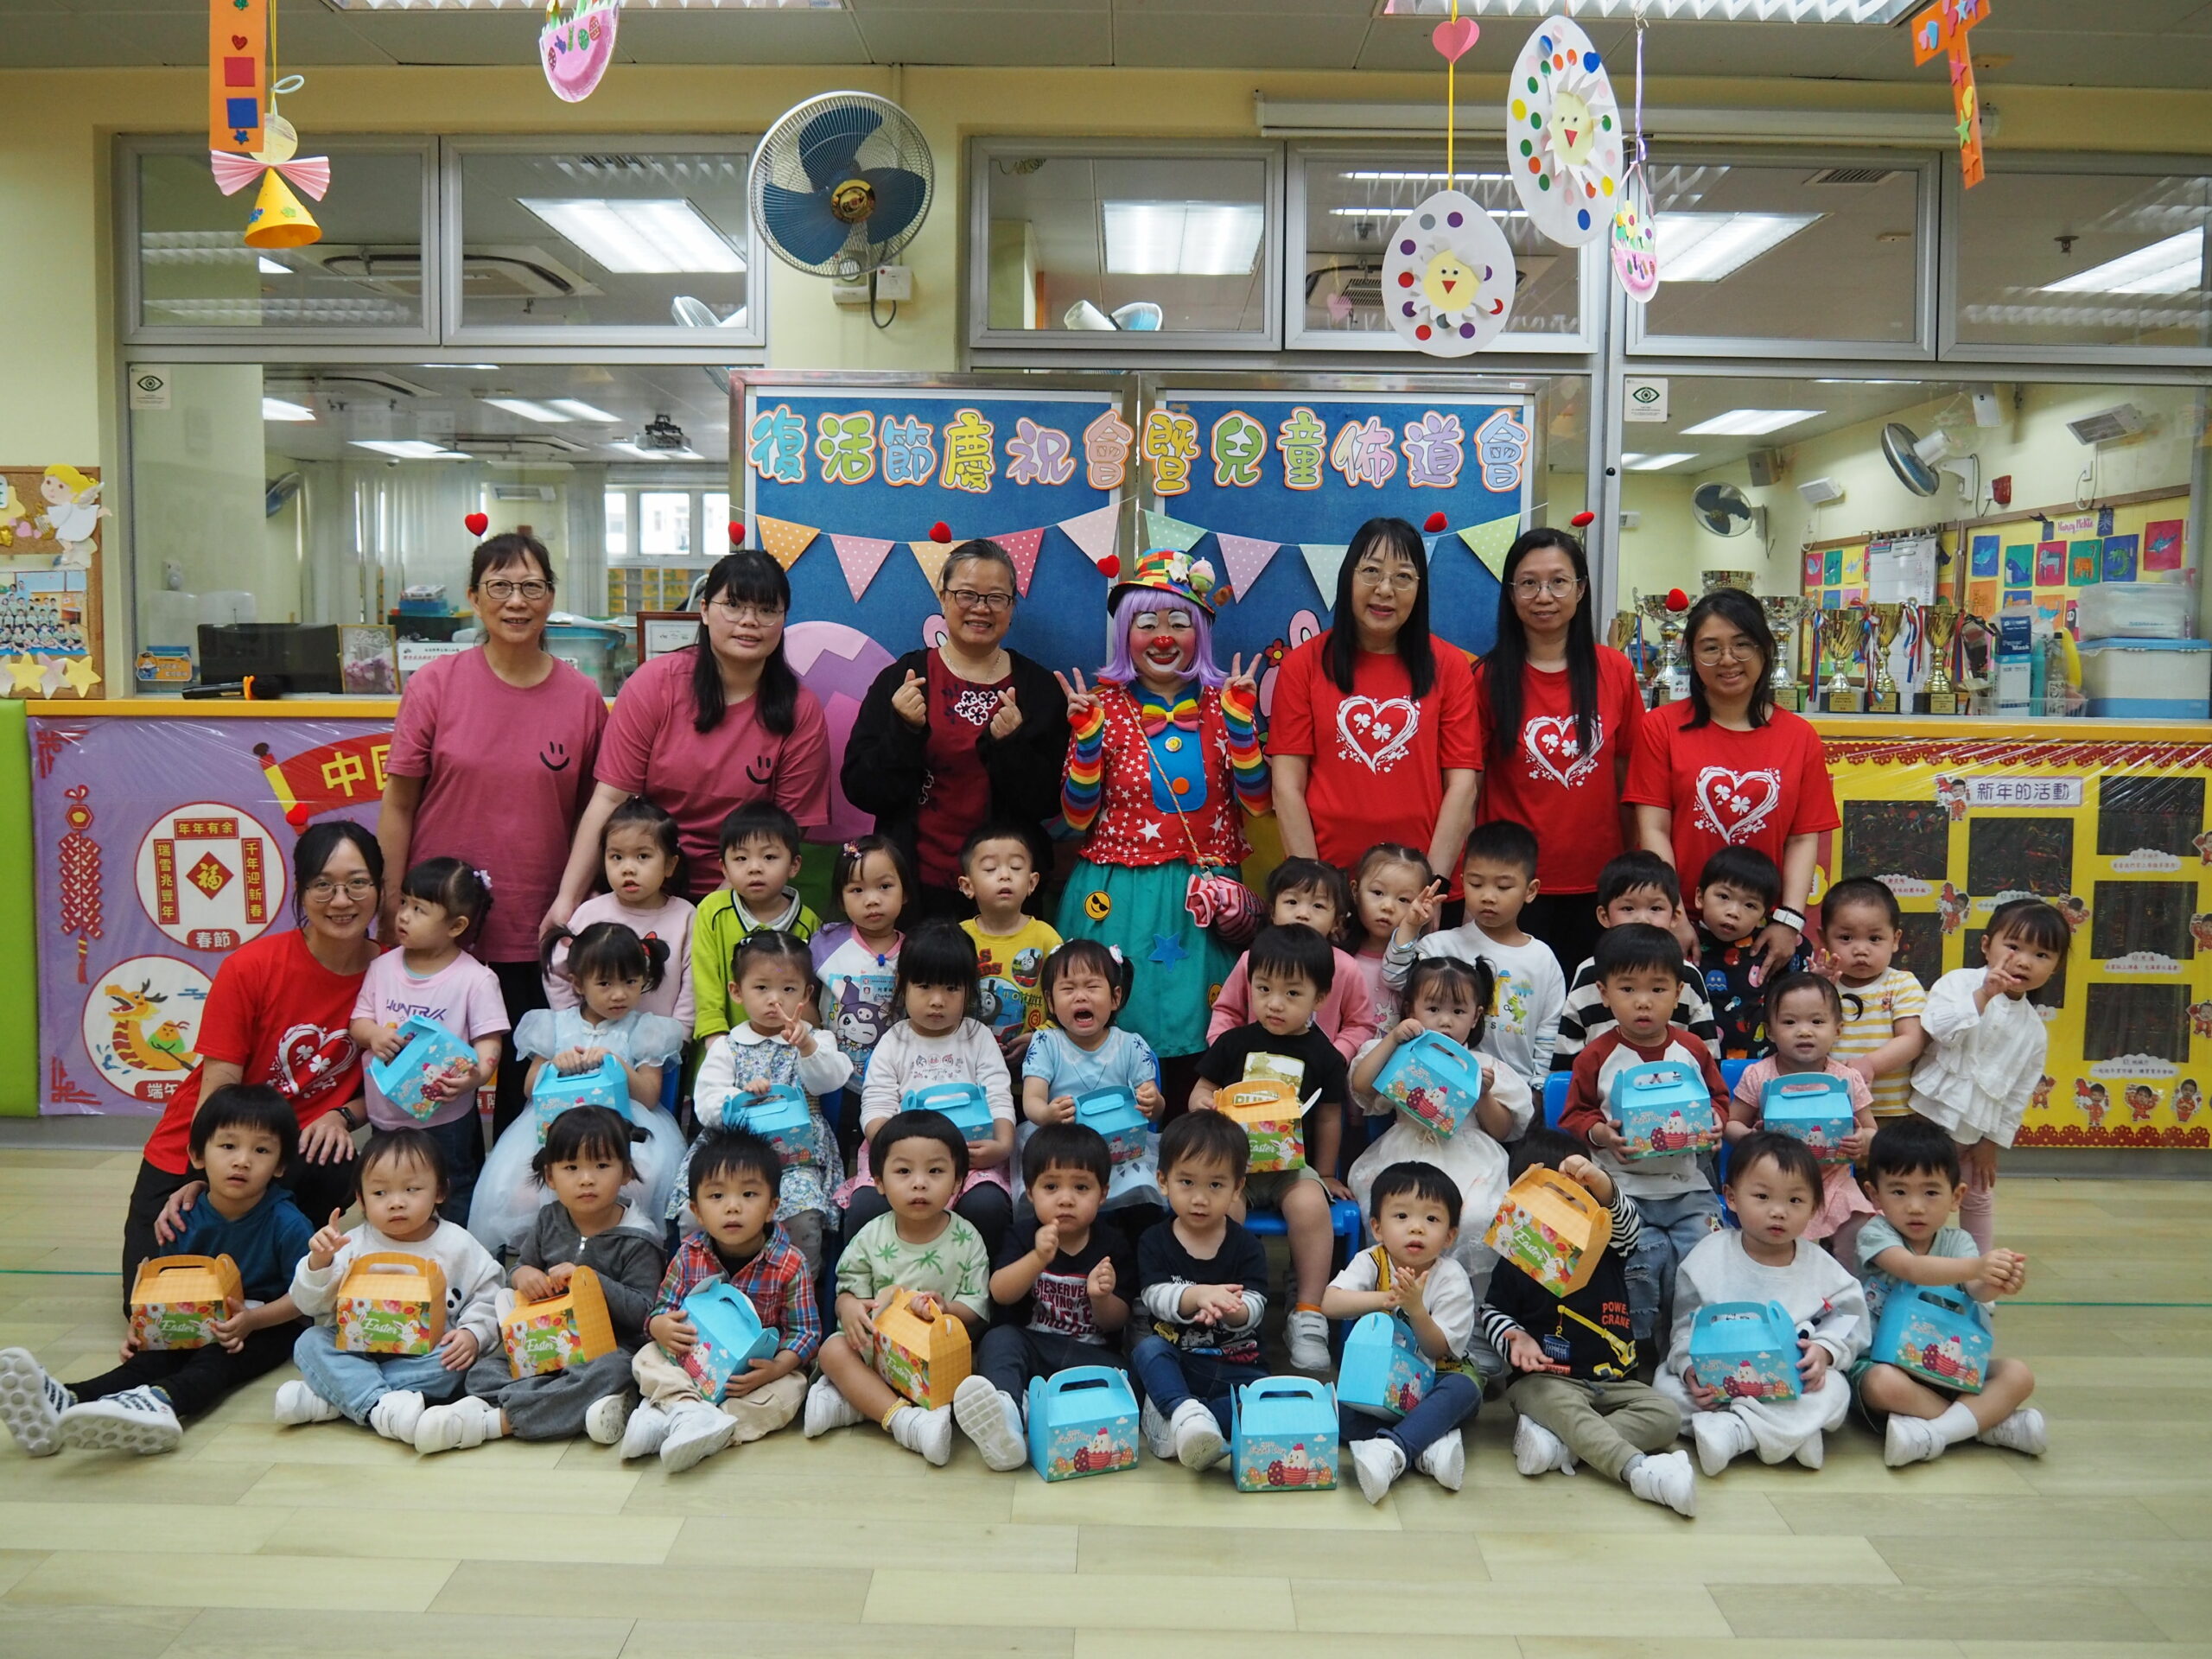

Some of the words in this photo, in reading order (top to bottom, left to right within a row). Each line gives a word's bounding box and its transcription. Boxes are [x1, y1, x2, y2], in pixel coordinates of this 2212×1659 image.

[1977, 783, 2069, 801] 新年的活動
[157, 844, 175, 918] 瑞雪兆豐年
[196, 862, 223, 891] 福
[245, 842, 263, 918] 千年迎新春
[196, 931, 231, 949] 春節
[1513, 1230, 1547, 1262] Easter
[1602, 1301, 1629, 1315] POWE
[160, 1319, 196, 1333] Easter
[363, 1318, 400, 1335] Easter
[1601, 1315, 1630, 1329] CRANE
[525, 1338, 555, 1352] Easter
[886, 1357, 913, 1381] Easter
